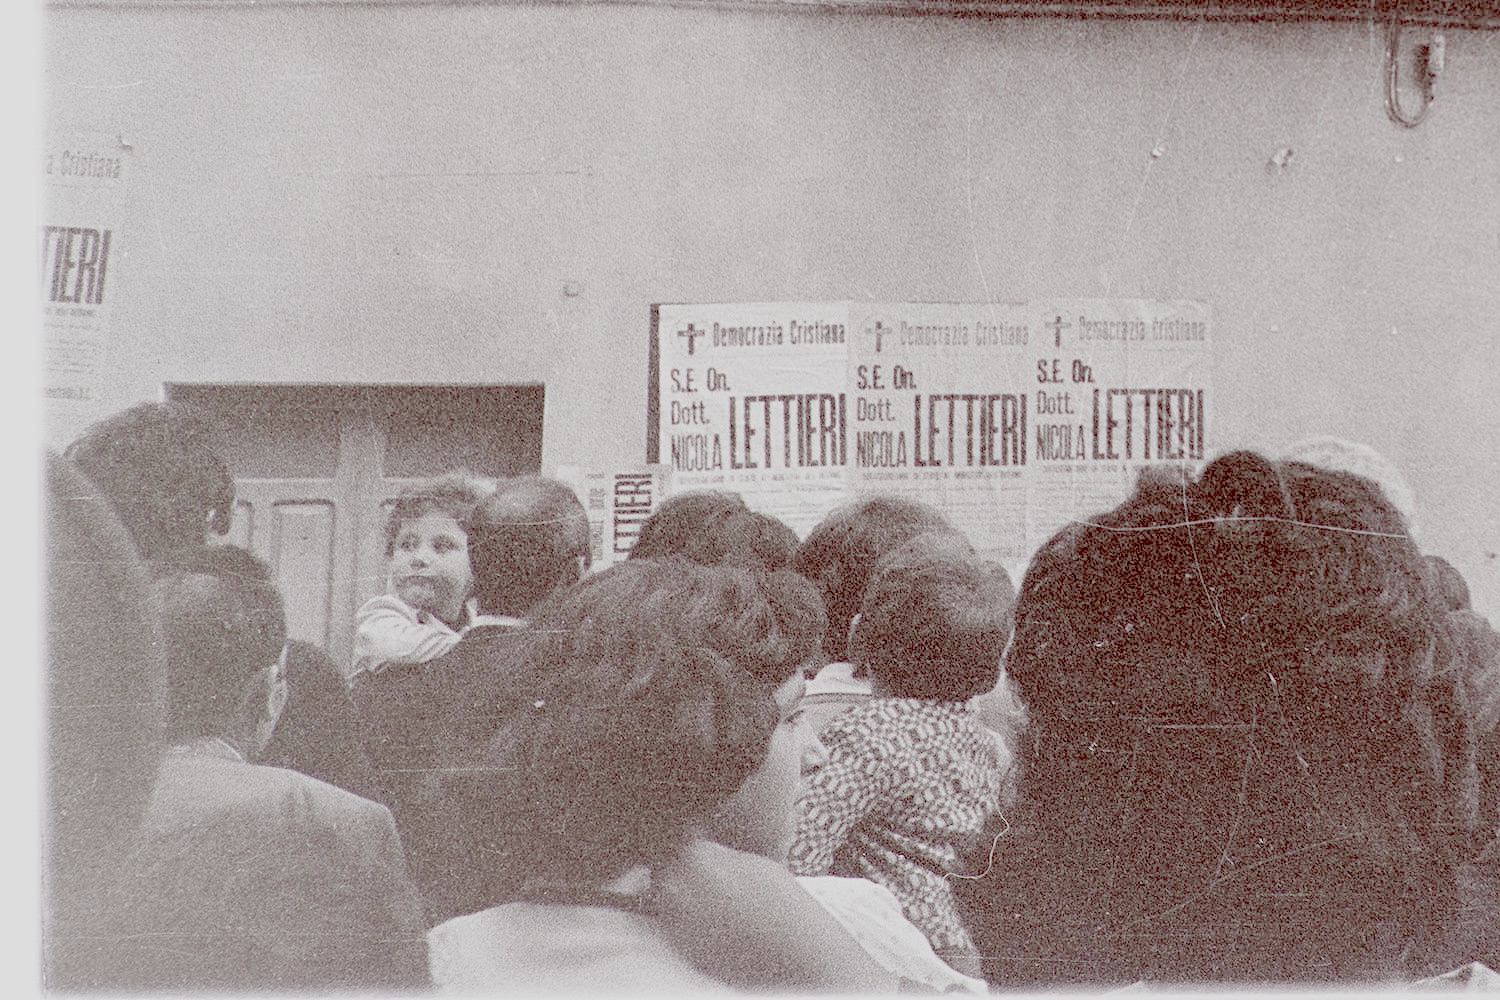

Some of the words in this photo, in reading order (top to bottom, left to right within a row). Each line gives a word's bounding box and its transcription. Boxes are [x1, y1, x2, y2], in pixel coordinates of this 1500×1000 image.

[713, 321, 783, 347] Democrazia
[790, 320, 845, 344] Cristiana
[901, 321, 969, 346] Democrazia
[976, 321, 1029, 346] Cristiana
[671, 368, 698, 392] S.E.
[706, 367, 731, 391] On.
[857, 365, 885, 390] S.E.
[893, 365, 917, 390] On.
[1037, 359, 1064, 383] S.E.
[1072, 359, 1095, 383] On.
[671, 401, 710, 425] Dott.
[857, 397, 895, 422] Dott.
[1037, 390, 1074, 414] Dott.
[729, 393, 847, 469] LETTIERI
[914, 394, 1027, 467] LETTIERI
[1092, 388, 1203, 460] LETTIERI
[671, 434, 722, 471] NICOLA
[856, 431, 907, 468] NICOLA
[1036, 424, 1085, 460] NICOLA
[614, 473, 652, 562] ETTIERI
